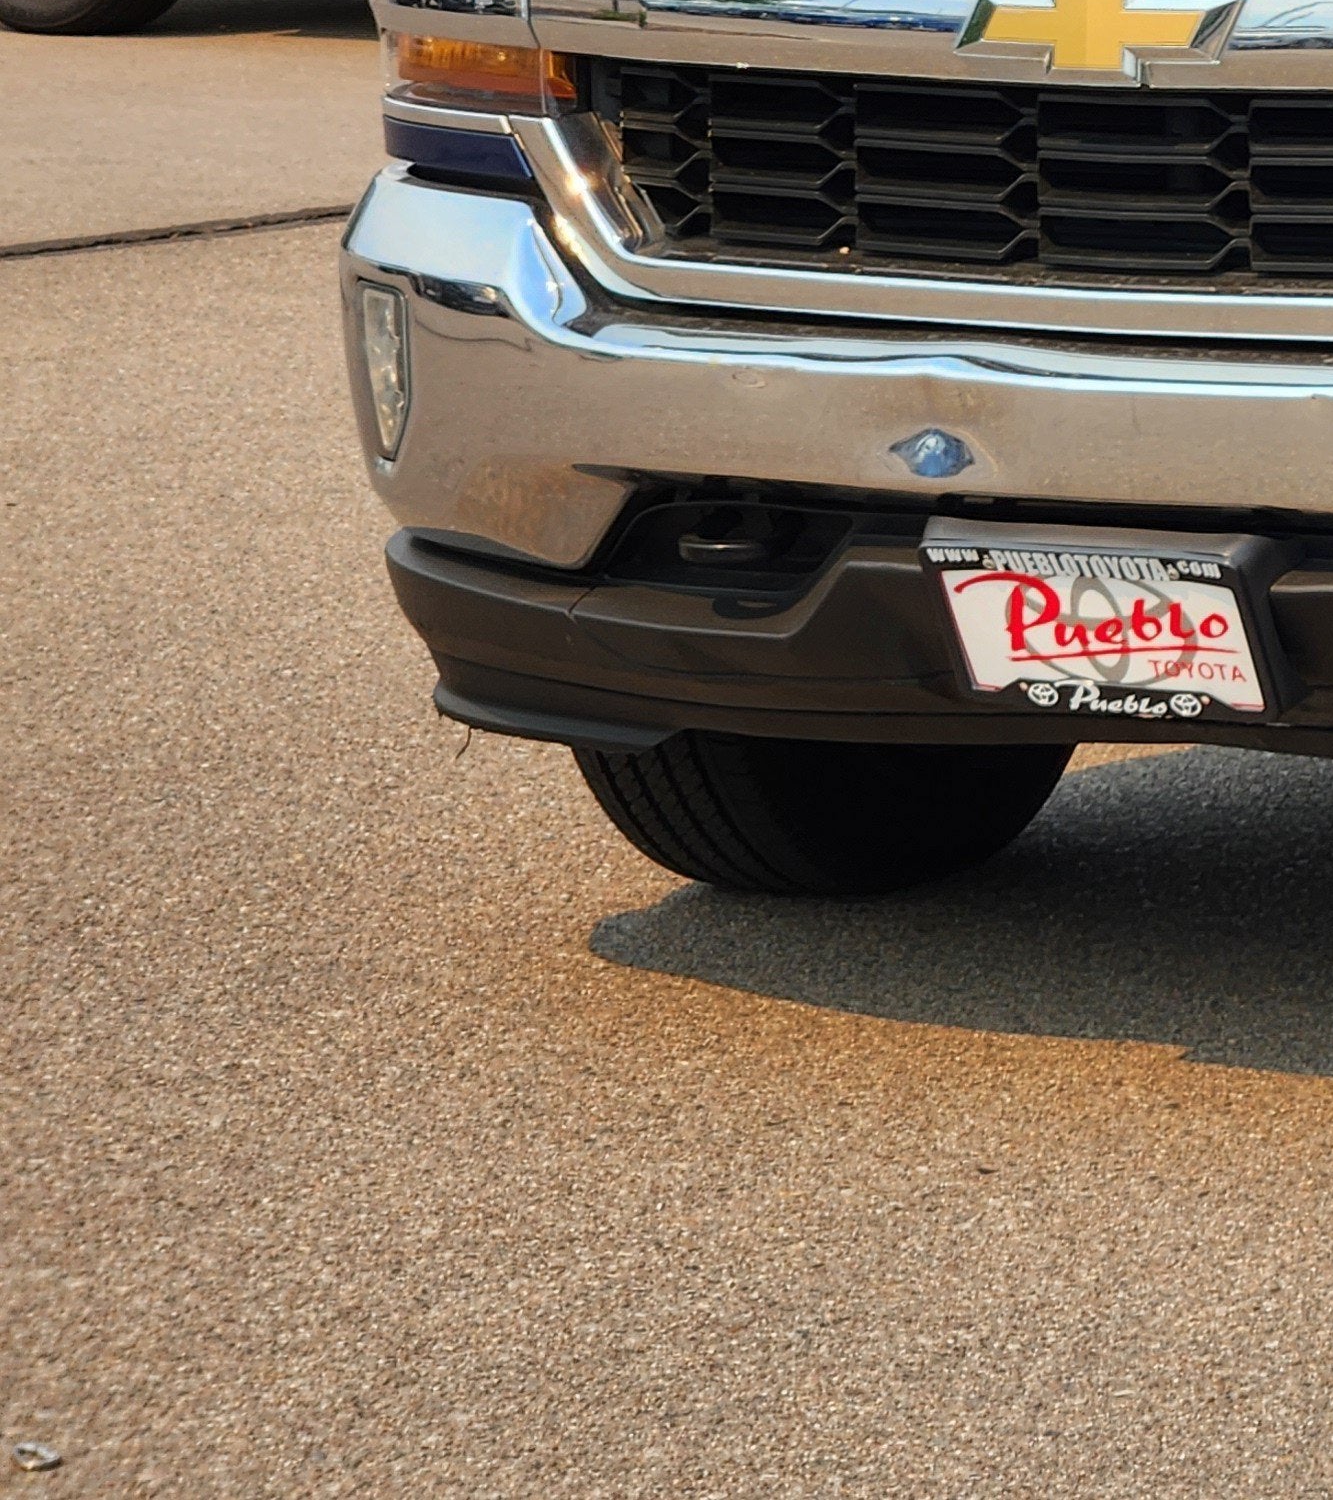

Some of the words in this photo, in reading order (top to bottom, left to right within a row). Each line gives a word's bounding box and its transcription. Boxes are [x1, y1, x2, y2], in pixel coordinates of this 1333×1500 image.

[954, 571, 1230, 652] Pueblo
[1148, 659, 1247, 683] TOYOTA
[1053, 679, 1168, 715] Pueblo
